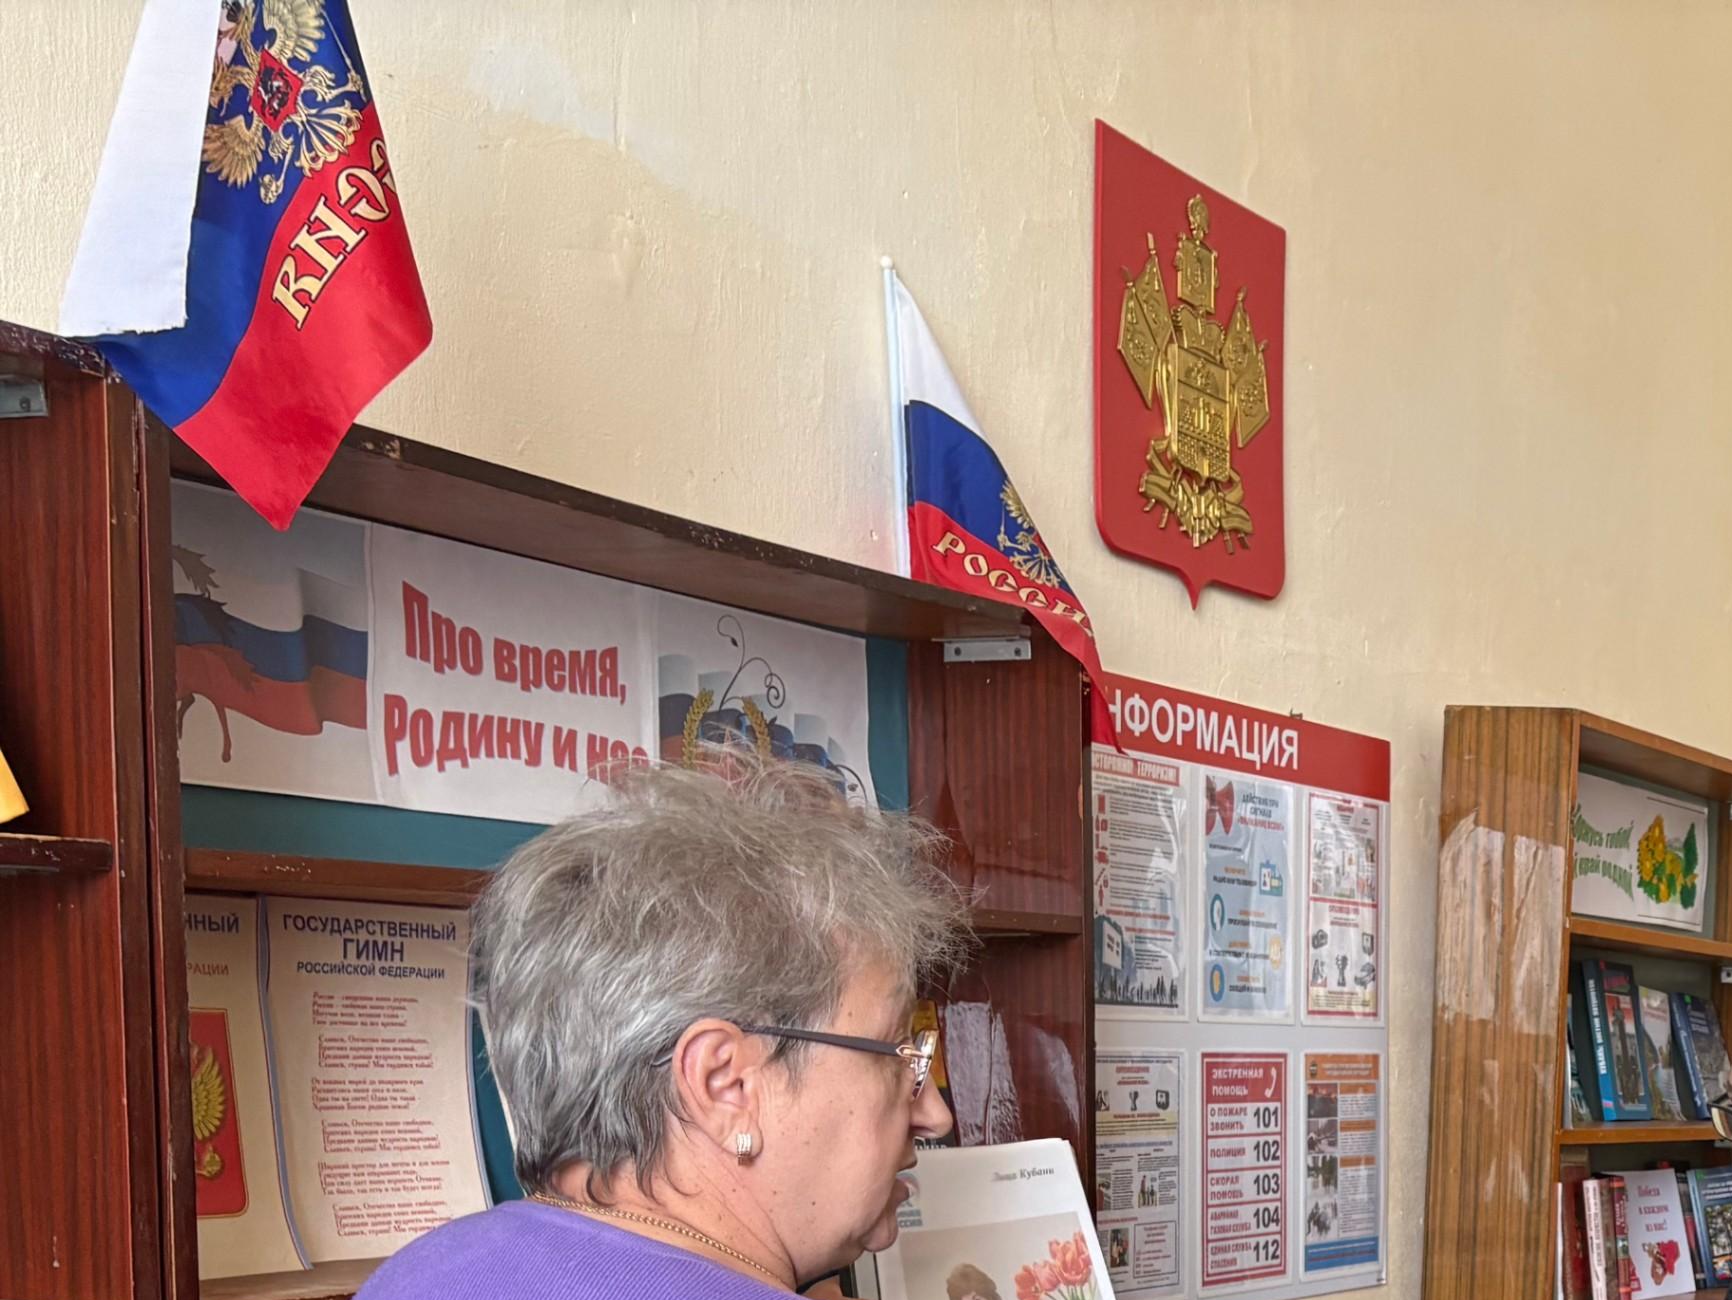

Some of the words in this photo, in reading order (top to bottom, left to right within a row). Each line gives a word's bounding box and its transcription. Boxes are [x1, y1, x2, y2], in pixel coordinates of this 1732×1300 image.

[932, 531, 1095, 638] РОССИ
[402, 580, 484, 676] Про
[494, 637, 627, 706] время,
[384, 693, 545, 777] Родину
[553, 725, 578, 773] и
[1109, 688, 1299, 771] НФОРМАЦИЯ
[282, 913, 457, 941] ГОСУДАРСТВЕННЫЙ
[342, 938, 405, 963] ГИМН
[296, 961, 376, 978] РОССИЙСКОЙ
[378, 965, 446, 980] ФЕДЕРАЦИИ
[1212, 1085, 1249, 1097] ПОМОЩЬ
[1253, 1106, 1279, 1129] 101
[1253, 1140, 1280, 1163] 102
[1253, 1173, 1280, 1196] 103
[1253, 1206, 1280, 1230] 104
[1253, 1239, 1280, 1263] 112
